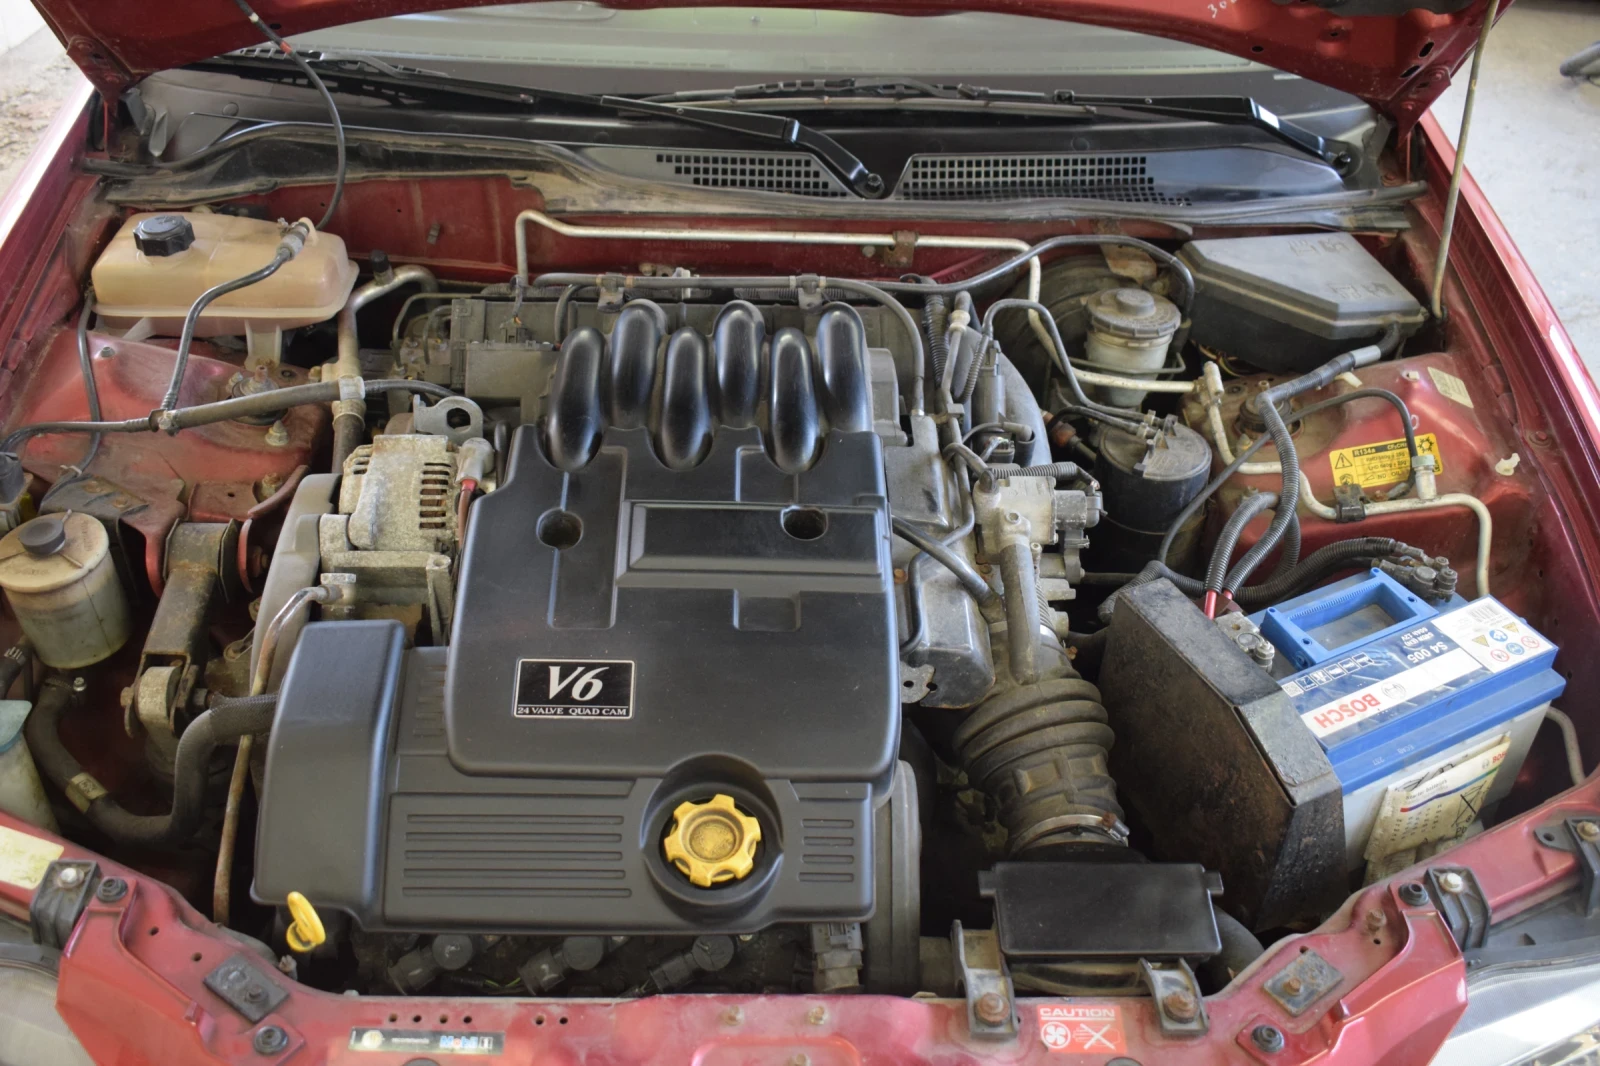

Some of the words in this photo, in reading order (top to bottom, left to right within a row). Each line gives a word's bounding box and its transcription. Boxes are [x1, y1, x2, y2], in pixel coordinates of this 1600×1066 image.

[1354, 448, 1375, 456] R134a
[1429, 641, 1449, 654] S4
[1407, 648, 1432, 664] 005
[548, 665, 610, 701] V6
[517, 707, 530, 715] 24
[531, 707, 564, 715] VALVE
[568, 707, 600, 716] QUAD
[601, 708, 627, 716] CAM
[1313, 693, 1381, 729] BOSCH
[1039, 1007, 1116, 1017] CAUTION
[439, 1035, 479, 1050] Mobil
